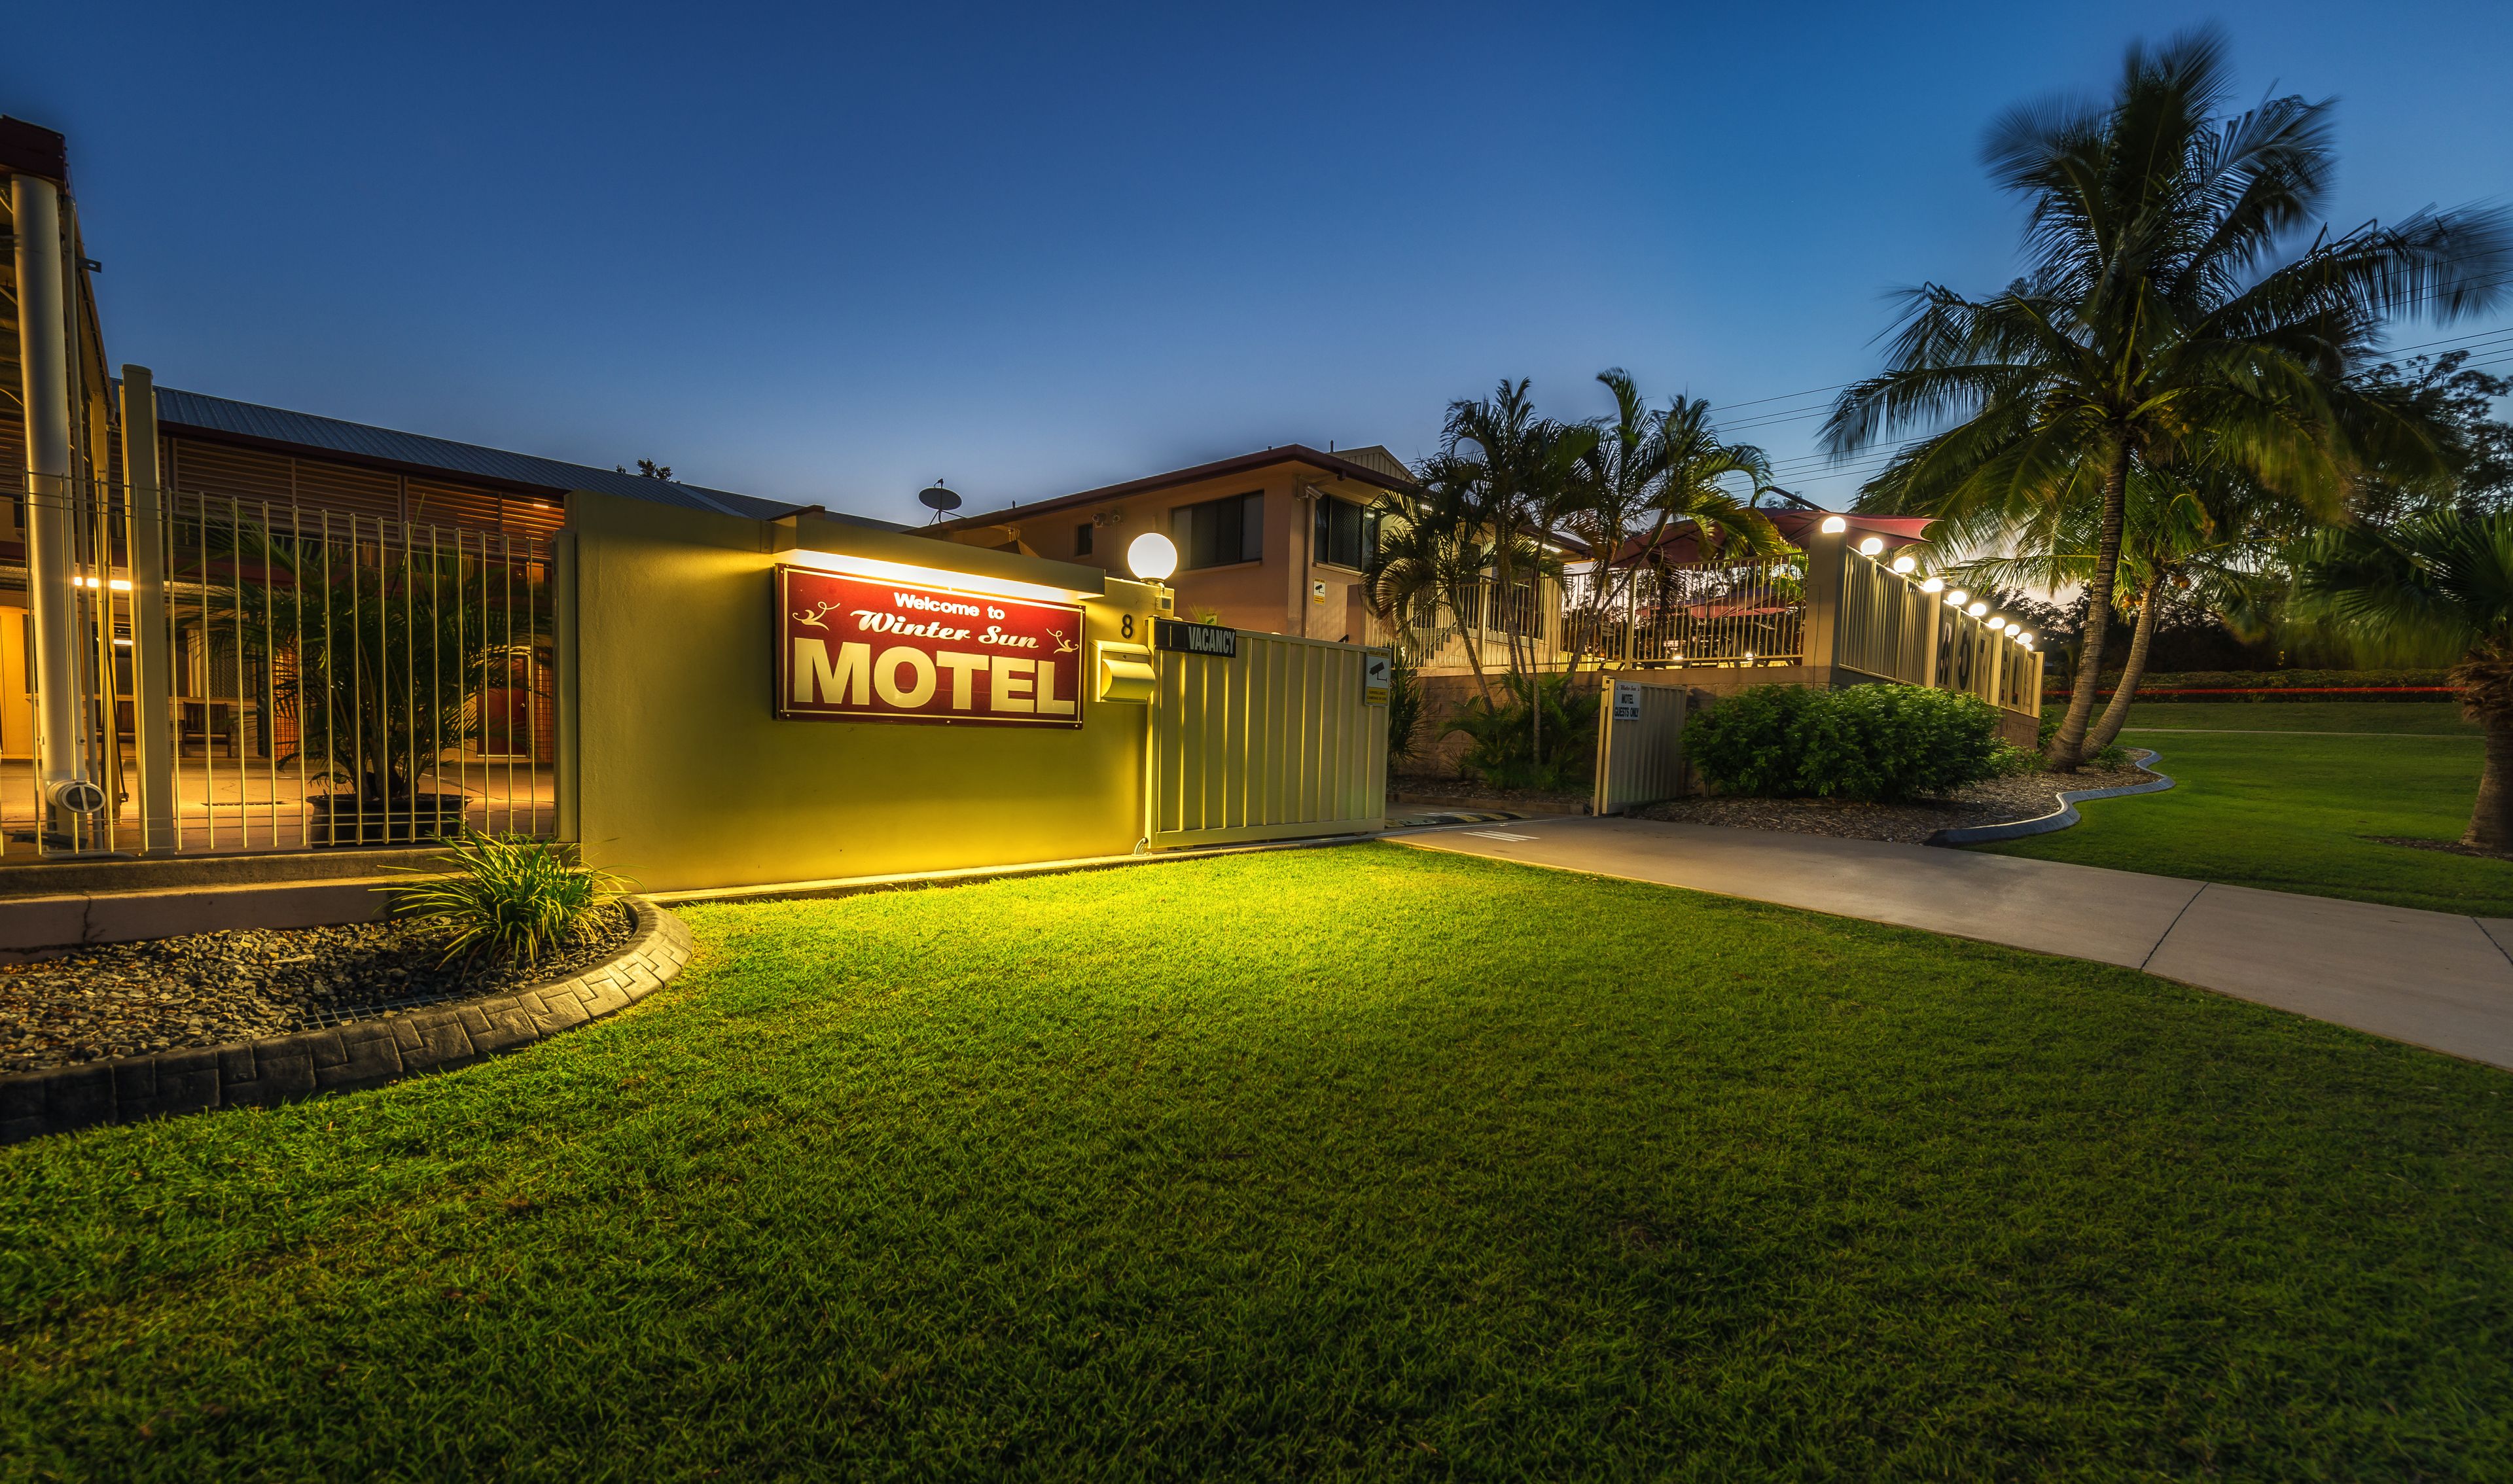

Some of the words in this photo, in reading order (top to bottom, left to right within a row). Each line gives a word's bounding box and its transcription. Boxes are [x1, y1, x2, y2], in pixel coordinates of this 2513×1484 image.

[894, 592, 980, 617] Welcome
[987, 605, 1005, 620] to
[850, 610, 971, 641] Winter
[978, 626, 1039, 648] Sun
[1121, 614, 1133, 639] 8
[1188, 626, 1236, 654] VACANCY
[794, 637, 1075, 715] MOTEL
[1614, 707, 1629, 717] GUESTS
[1630, 707, 1639, 717] ONLY
[1621, 694, 1633, 704] MOTEL
